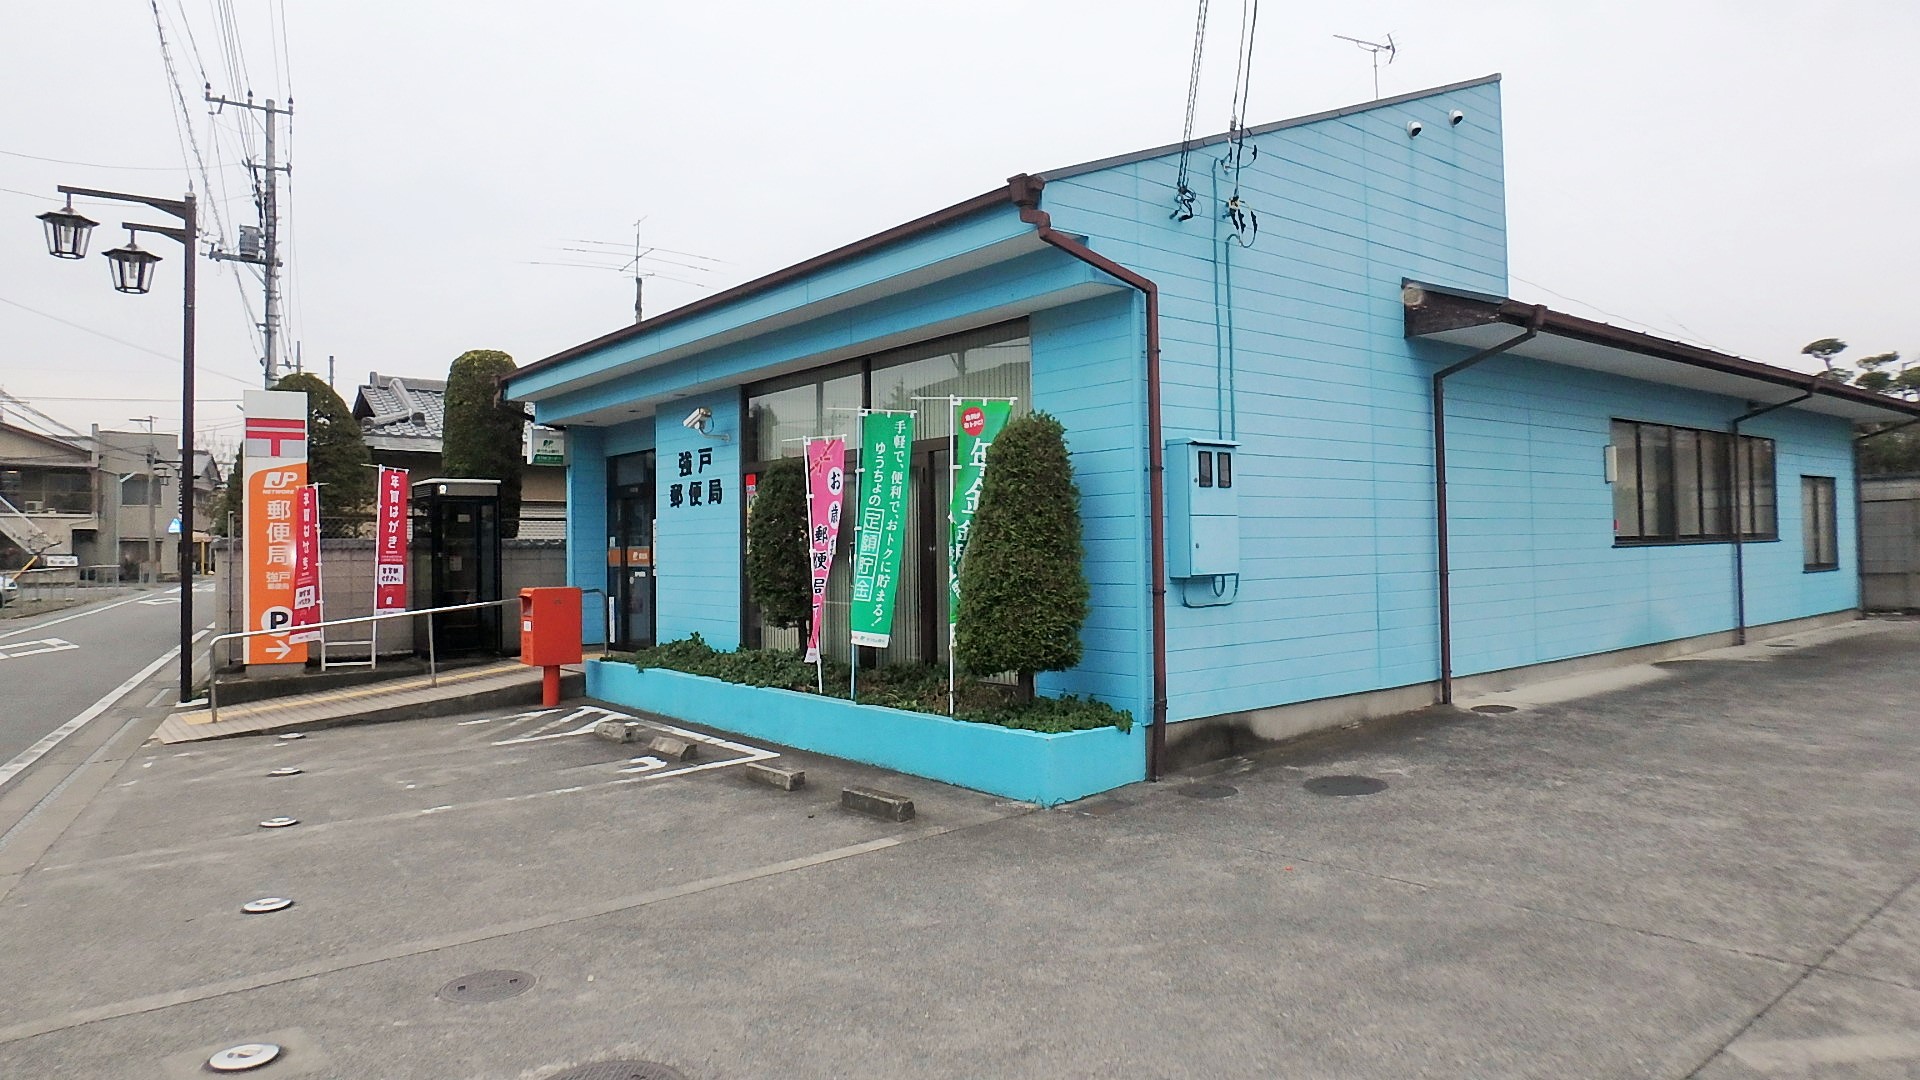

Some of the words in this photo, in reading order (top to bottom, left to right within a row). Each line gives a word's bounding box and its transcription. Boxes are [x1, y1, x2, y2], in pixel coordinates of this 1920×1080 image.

[679, 447, 713, 477] 強戸
[263, 471, 298, 489] JP
[669, 478, 723, 509] 郵便局
[388, 475, 400, 549] 年賀はがき
[853, 441, 886, 602] ゆうちょの定額貯金
[266, 499, 292, 566] 郵便局
[265, 571, 291, 583] 強戸
[270, 611, 289, 630] P
